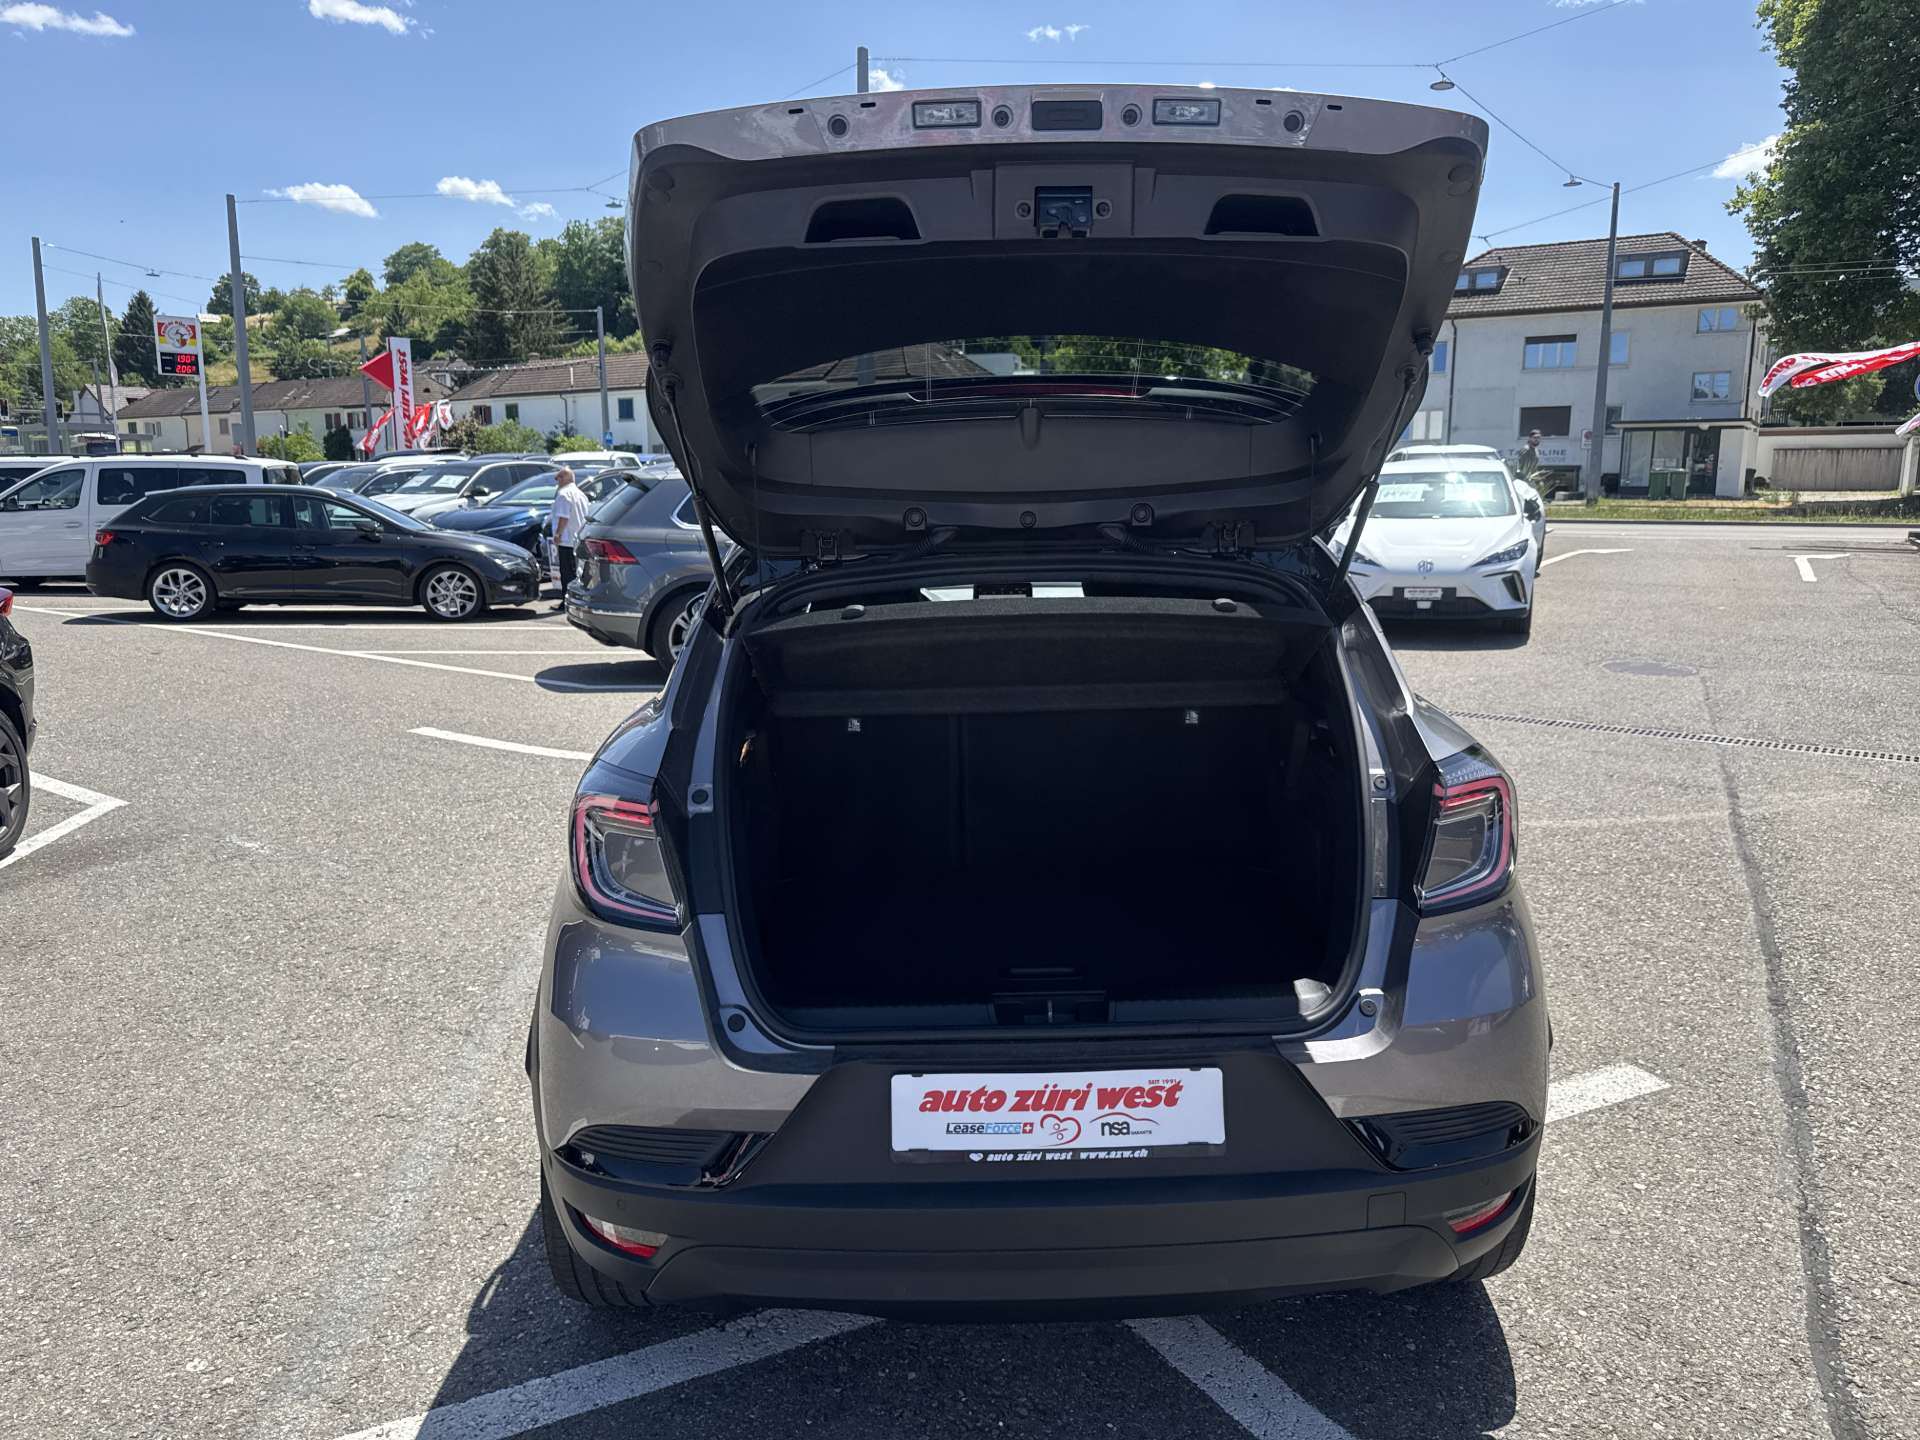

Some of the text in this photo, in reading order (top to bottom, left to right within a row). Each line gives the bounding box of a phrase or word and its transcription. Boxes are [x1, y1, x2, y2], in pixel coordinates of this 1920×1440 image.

[397, 348, 409, 386] west
[919, 1080, 1183, 1113] auto züri west
[946, 1122, 1022, 1135] LeaseForce
[1101, 1121, 1130, 1136] nsa
[986, 1153, 1014, 1162] auto
[1016, 1151, 1042, 1161] züri
[1045, 1150, 1073, 1160] west
